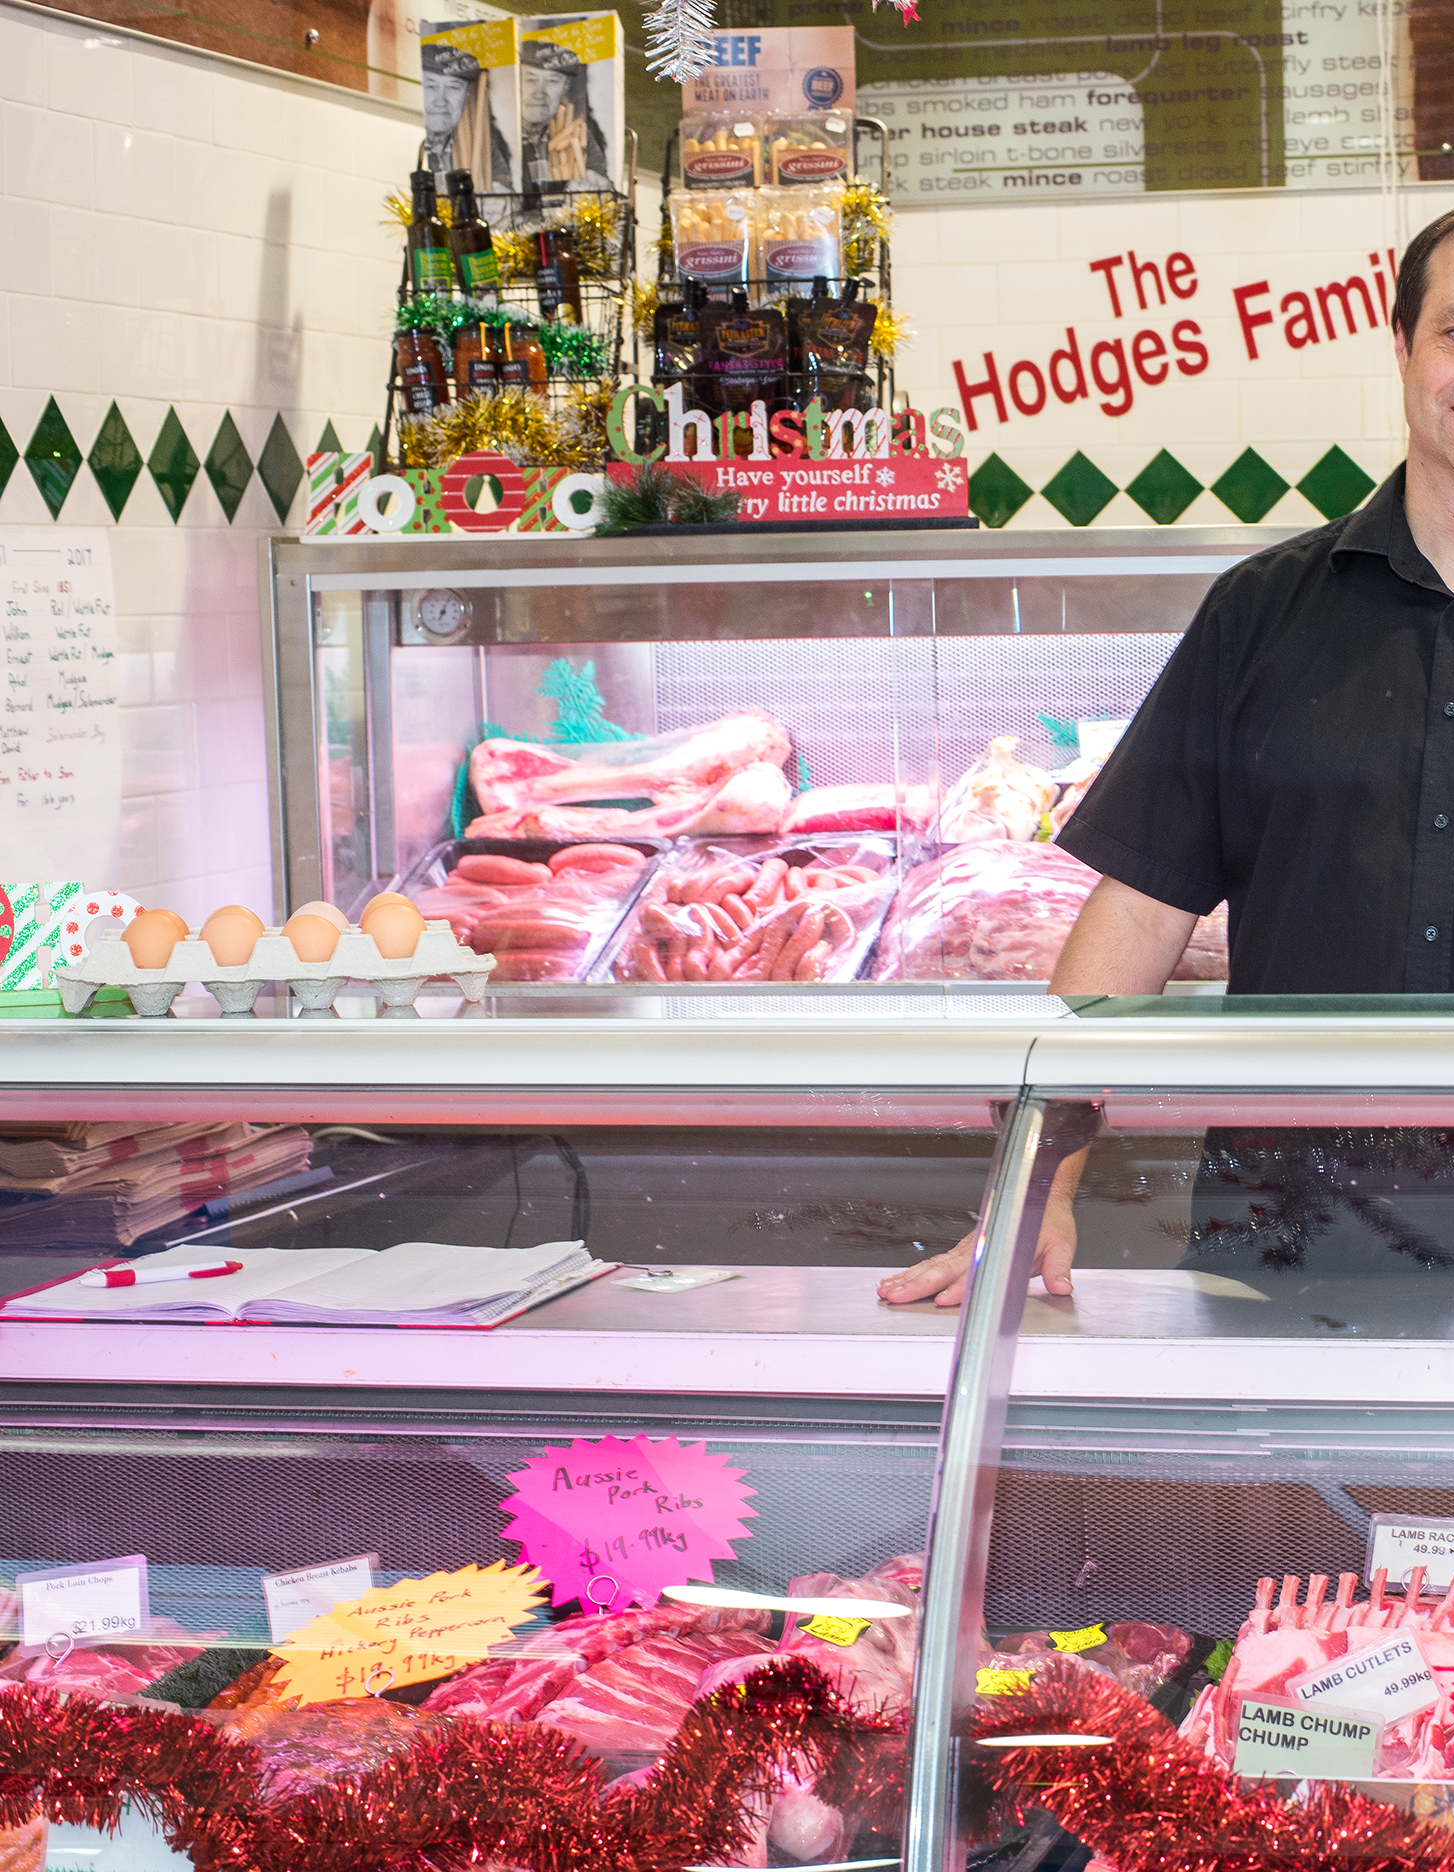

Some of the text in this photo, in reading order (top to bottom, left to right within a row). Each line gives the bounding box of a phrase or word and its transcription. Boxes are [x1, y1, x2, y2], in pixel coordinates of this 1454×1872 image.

[1105, 30, 1309, 55] lamb leg roast
[714, 73, 761, 88] GREATEST
[694, 87, 770, 102] MEAT ON EARTH
[906, 92, 1010, 116] smoked
[1018, 88, 1077, 111] ham
[1086, 82, 1251, 108] forequarter
[920, 123, 1002, 141] house
[1012, 116, 1089, 136] steak
[1283, 107, 1350, 126] lamb
[918, 146, 997, 168] sirloin
[1006, 142, 1093, 164] t-bone
[1285, 134, 1330, 155] eye
[694, 158, 745, 172] grissini
[786, 158, 839, 172] grissini
[918, 171, 993, 194] steak
[1002, 167, 1083, 189] mince
[686, 252, 738, 268] grissini
[1089, 251, 1199, 319] The
[951, 318, 1210, 432] Hodges
[606, 381, 965, 465] Christmas
[716, 464, 872, 493] Have yourself
[777, 489, 827, 512] little
[831, 489, 940, 512] christmas
[6, 600, 28, 617] John
[552, 1466, 640, 1491] Aussie
[607, 1480, 659, 1504] Pork
[655, 1493, 704, 1514] Ribs
[1390, 1527, 1427, 1542] LAMB
[578, 1526, 689, 1575] $19.99kg
[1412, 1544, 1447, 1556] 49.99
[46, 1575, 114, 1591] Pork Loin Chops
[274, 1562, 359, 1588] Chicken Breast Kebabs
[346, 1588, 473, 1618] Aussie Pork
[72, 1615, 137, 1635] $21.99kg
[374, 1613, 431, 1630] Ribs
[319, 1615, 507, 1661] Hickory Peppercorn
[1300, 1640, 1413, 1701] LAMB CUTLETS
[1383, 1669, 1433, 1698] 49.99kg
[1241, 1704, 1372, 1741] LAMB CHUMP
[1238, 1726, 1310, 1752] CHUMP
